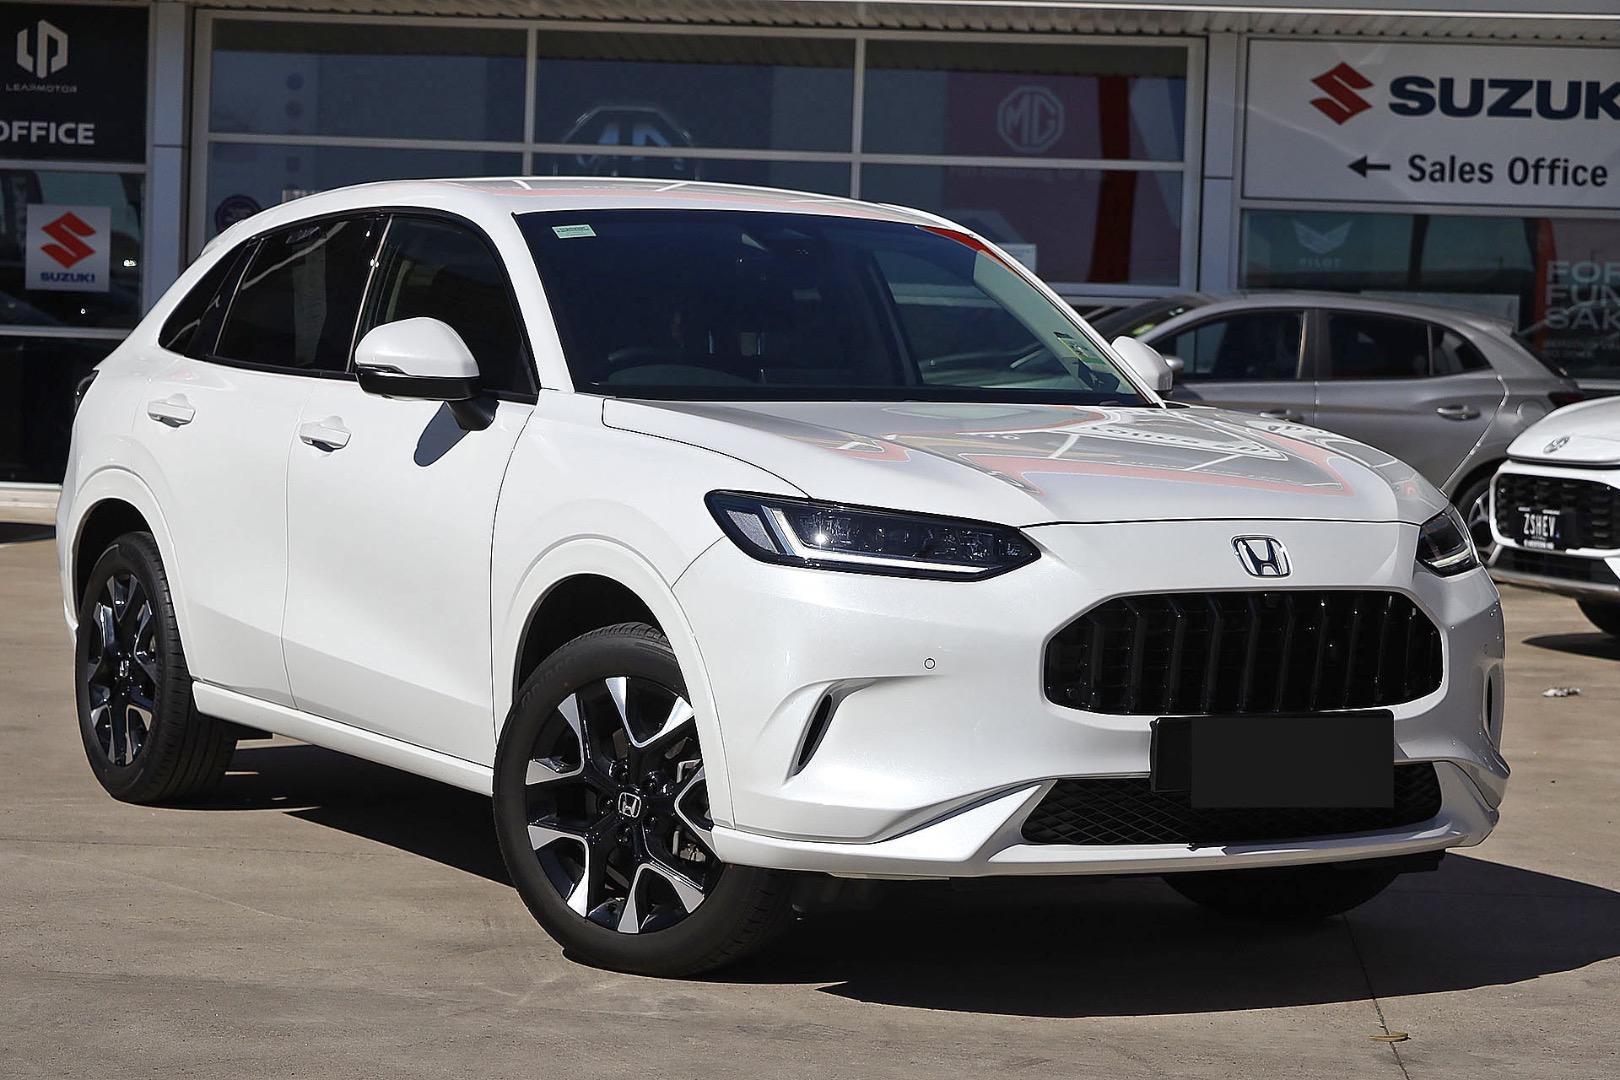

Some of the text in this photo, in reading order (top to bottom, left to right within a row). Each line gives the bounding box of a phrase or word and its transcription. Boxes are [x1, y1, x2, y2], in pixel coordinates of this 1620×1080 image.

[1005, 93, 1056, 145] MG
[1408, 154, 1608, 188] Sales Office
[39, 271, 96, 284] SUZUKI
